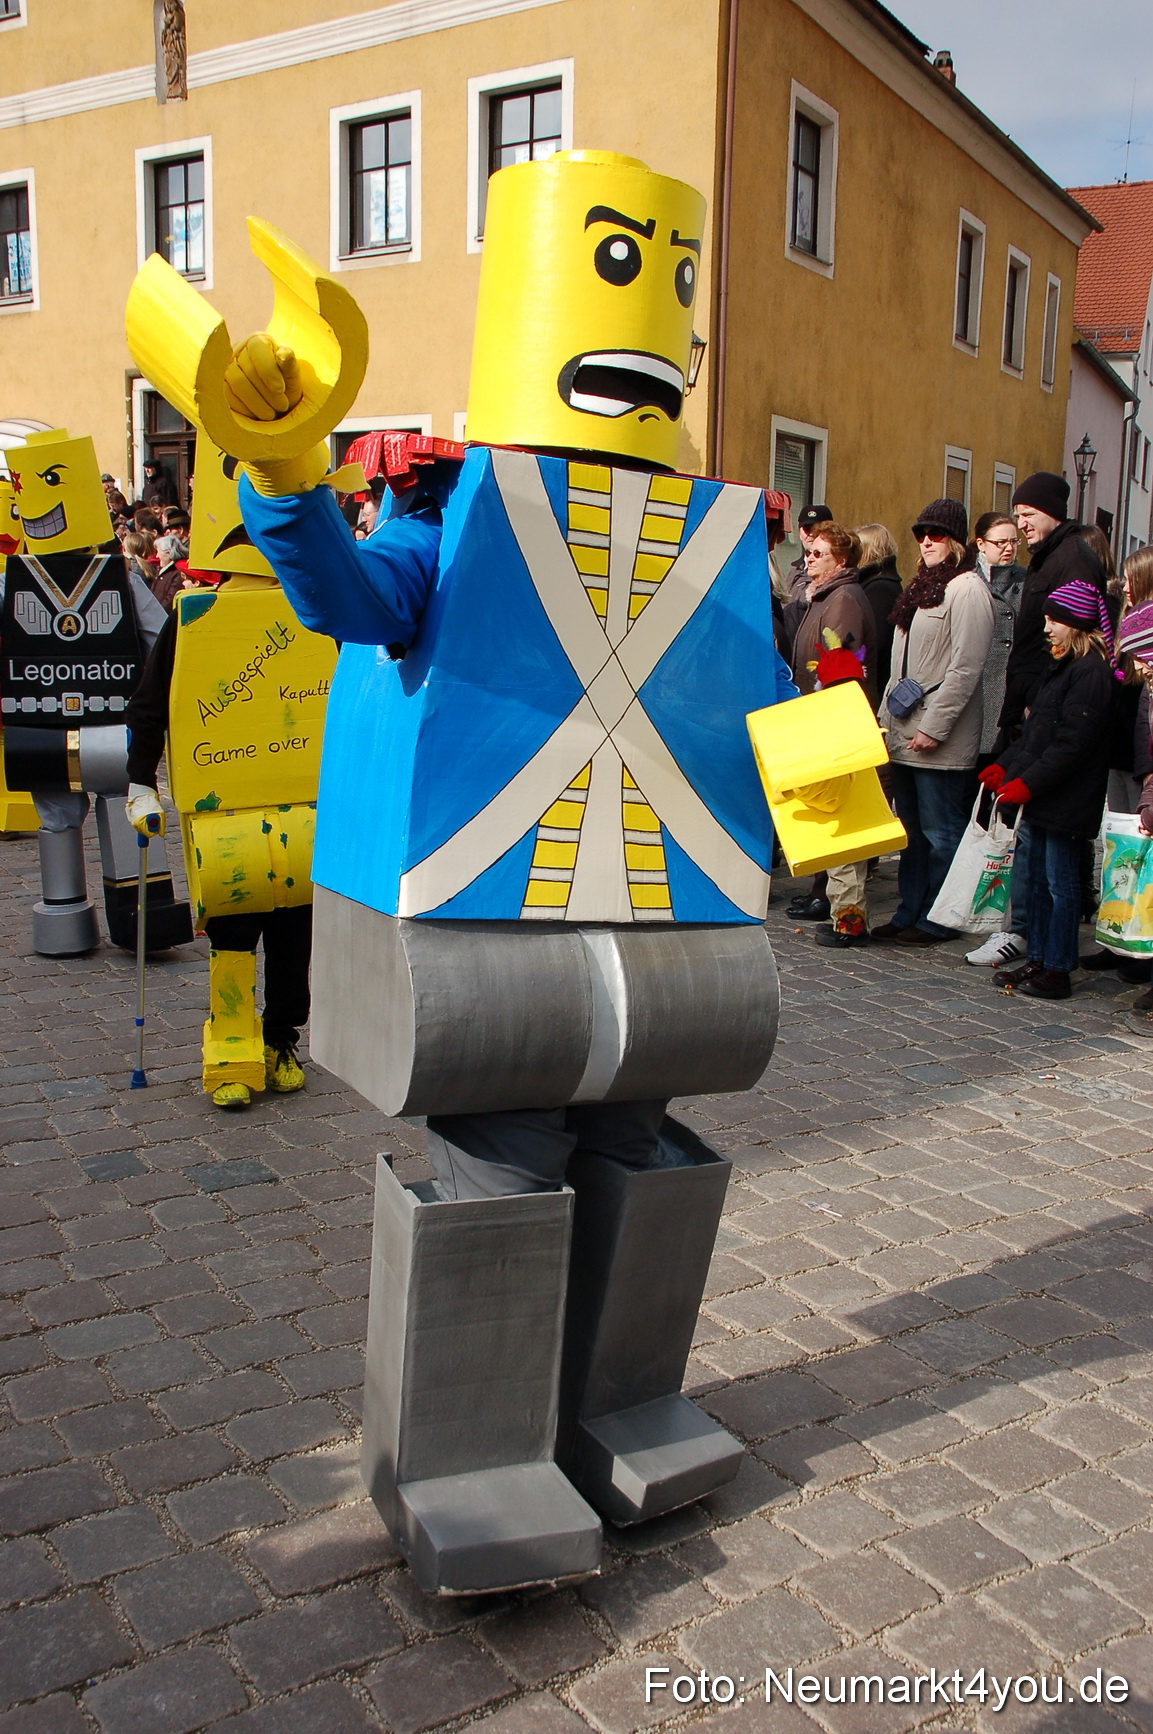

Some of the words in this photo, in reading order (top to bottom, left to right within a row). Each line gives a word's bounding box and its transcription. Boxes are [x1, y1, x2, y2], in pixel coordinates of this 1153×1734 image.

[61, 615, 78, 635] A
[8, 659, 136, 686] Legonator
[196, 621, 296, 727] Ausgespielt
[279, 680, 329, 704] Kaputt
[192, 742, 257, 767] Game
[268, 737, 310, 753] over
